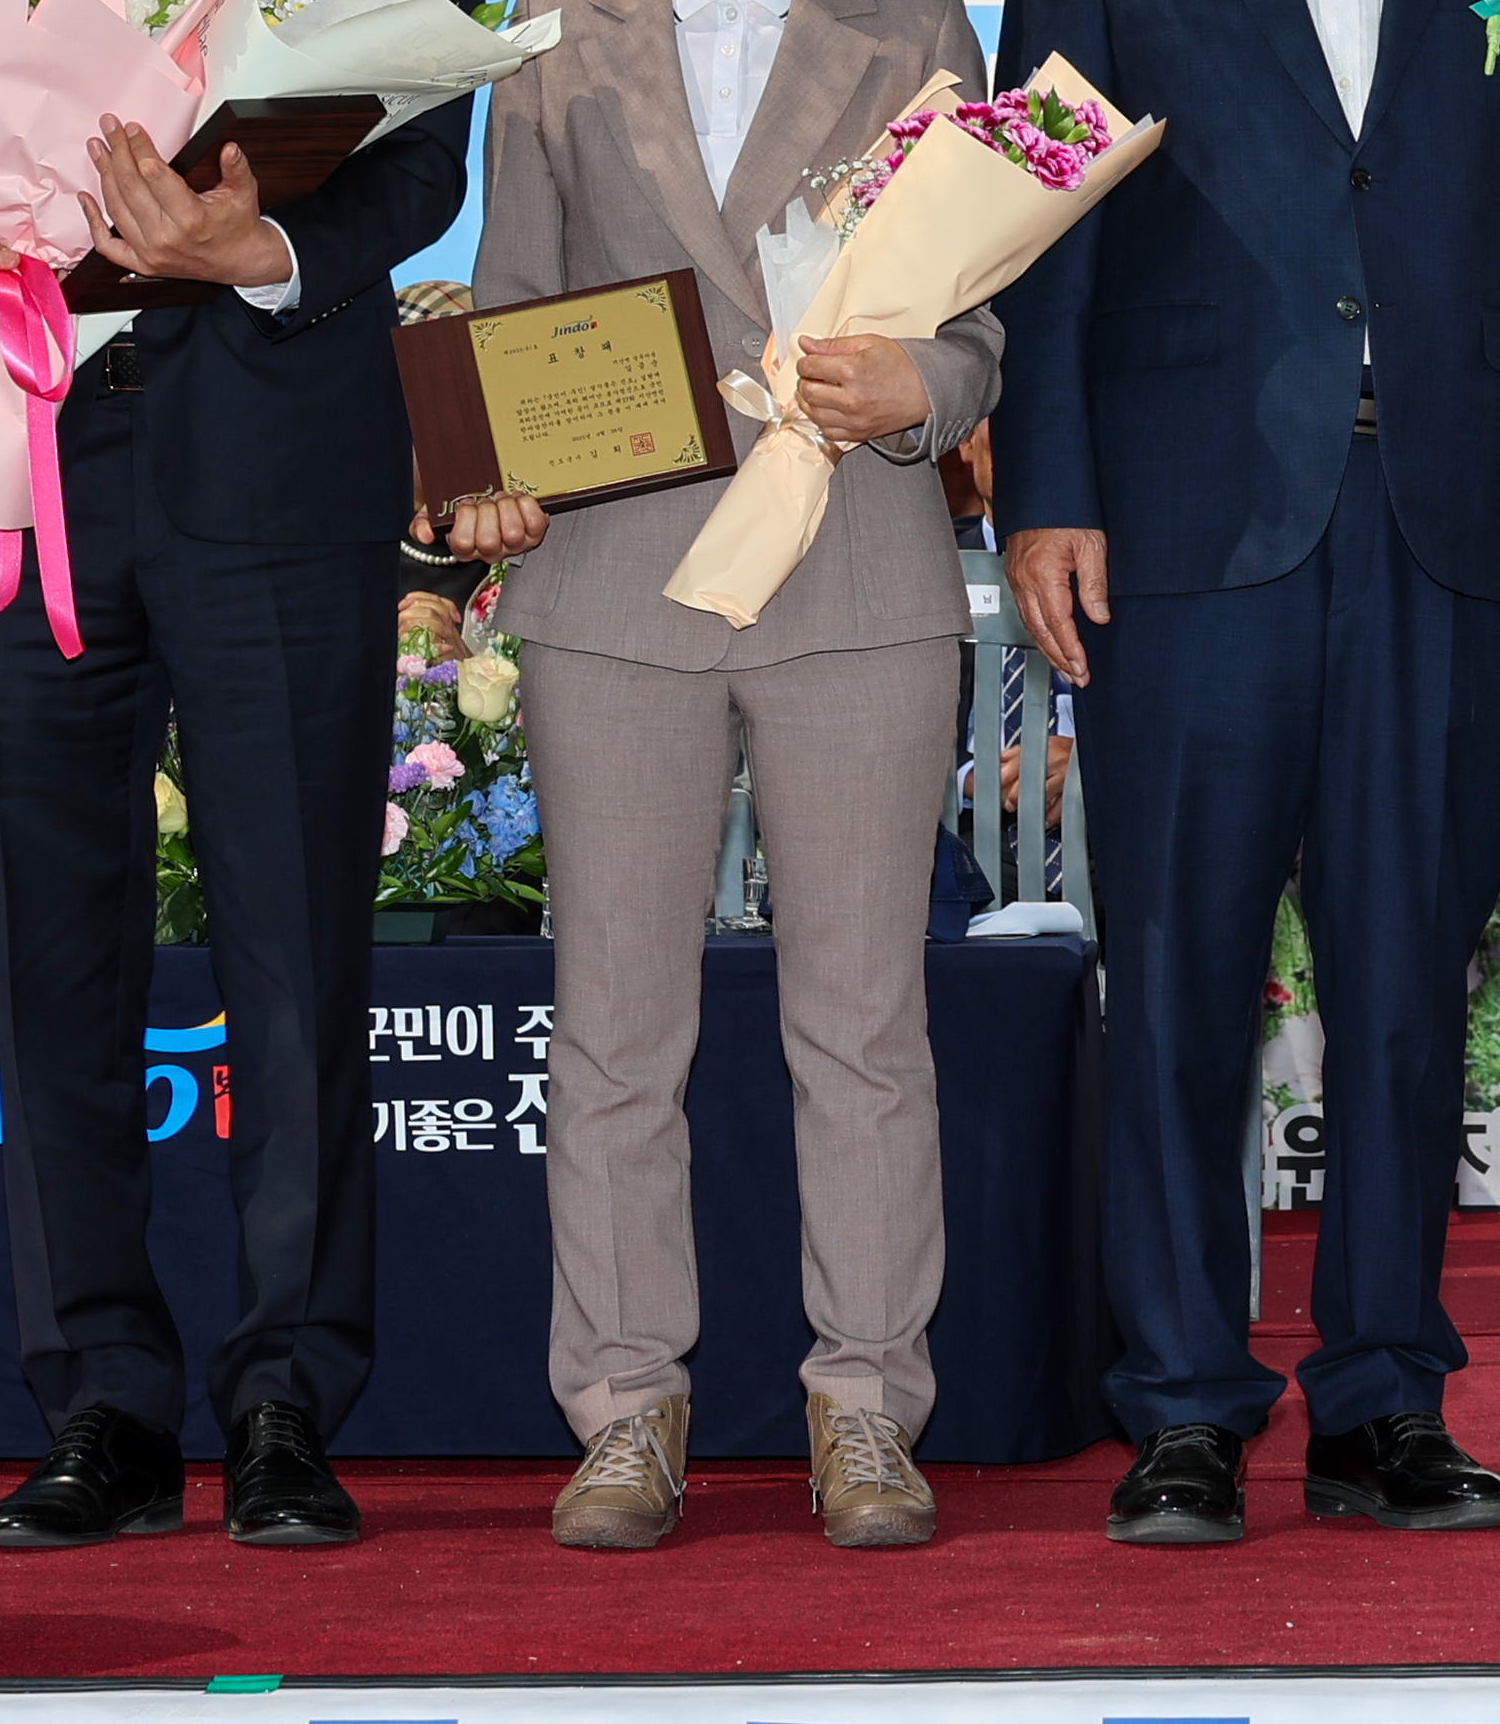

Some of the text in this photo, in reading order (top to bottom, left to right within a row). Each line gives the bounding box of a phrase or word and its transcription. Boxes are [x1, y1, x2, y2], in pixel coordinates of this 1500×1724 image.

[551, 323, 588, 338] Jindo
[574, 346, 584, 358] 창
[514, 1005, 555, 1060] 주
